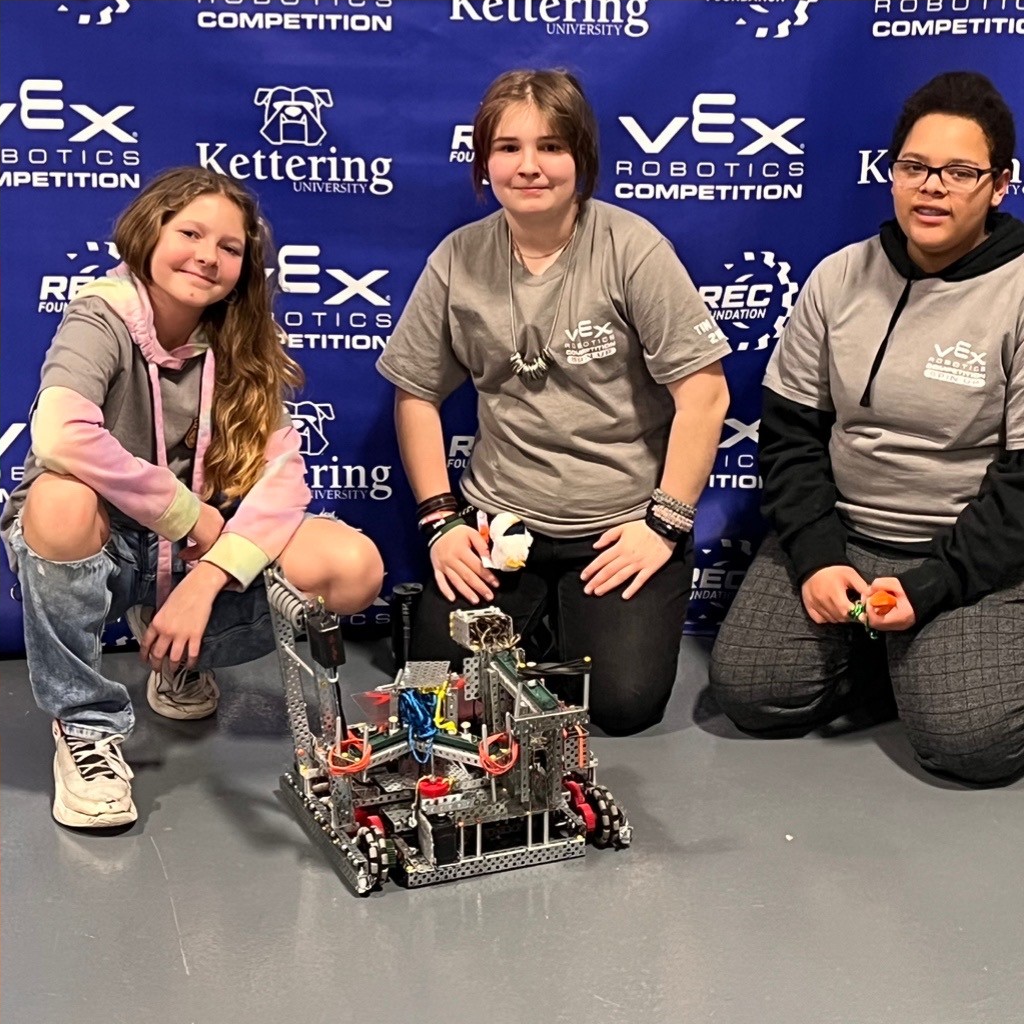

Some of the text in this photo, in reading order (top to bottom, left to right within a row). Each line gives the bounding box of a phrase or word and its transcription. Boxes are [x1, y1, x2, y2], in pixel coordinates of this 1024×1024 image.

[197, 11, 392, 32] COMPETITION
[546, 23, 622, 36] UNIVERSITY
[872, 18, 1024, 37] COMPETITI
[618, 93, 806, 155] VEX
[1, 148, 140, 166] BOTICS
[196, 143, 393, 195] Kettering
[616, 161, 804, 177] ROBOTICS
[0, 171, 139, 188] PETITION
[293, 182, 368, 194] UNIVERSITY
[615, 183, 803, 200] COMPETITION
[264, 245, 391, 306] EX
[284, 311, 392, 328] OTICS
[714, 308, 766, 320] NDATION
[565, 320, 613, 342] VEX
[278, 334, 391, 350] ETITION
[934, 340, 987, 365] VEX
[928, 357, 986, 372] ROBOTICS
[312, 490, 367, 499] IVERSITY
